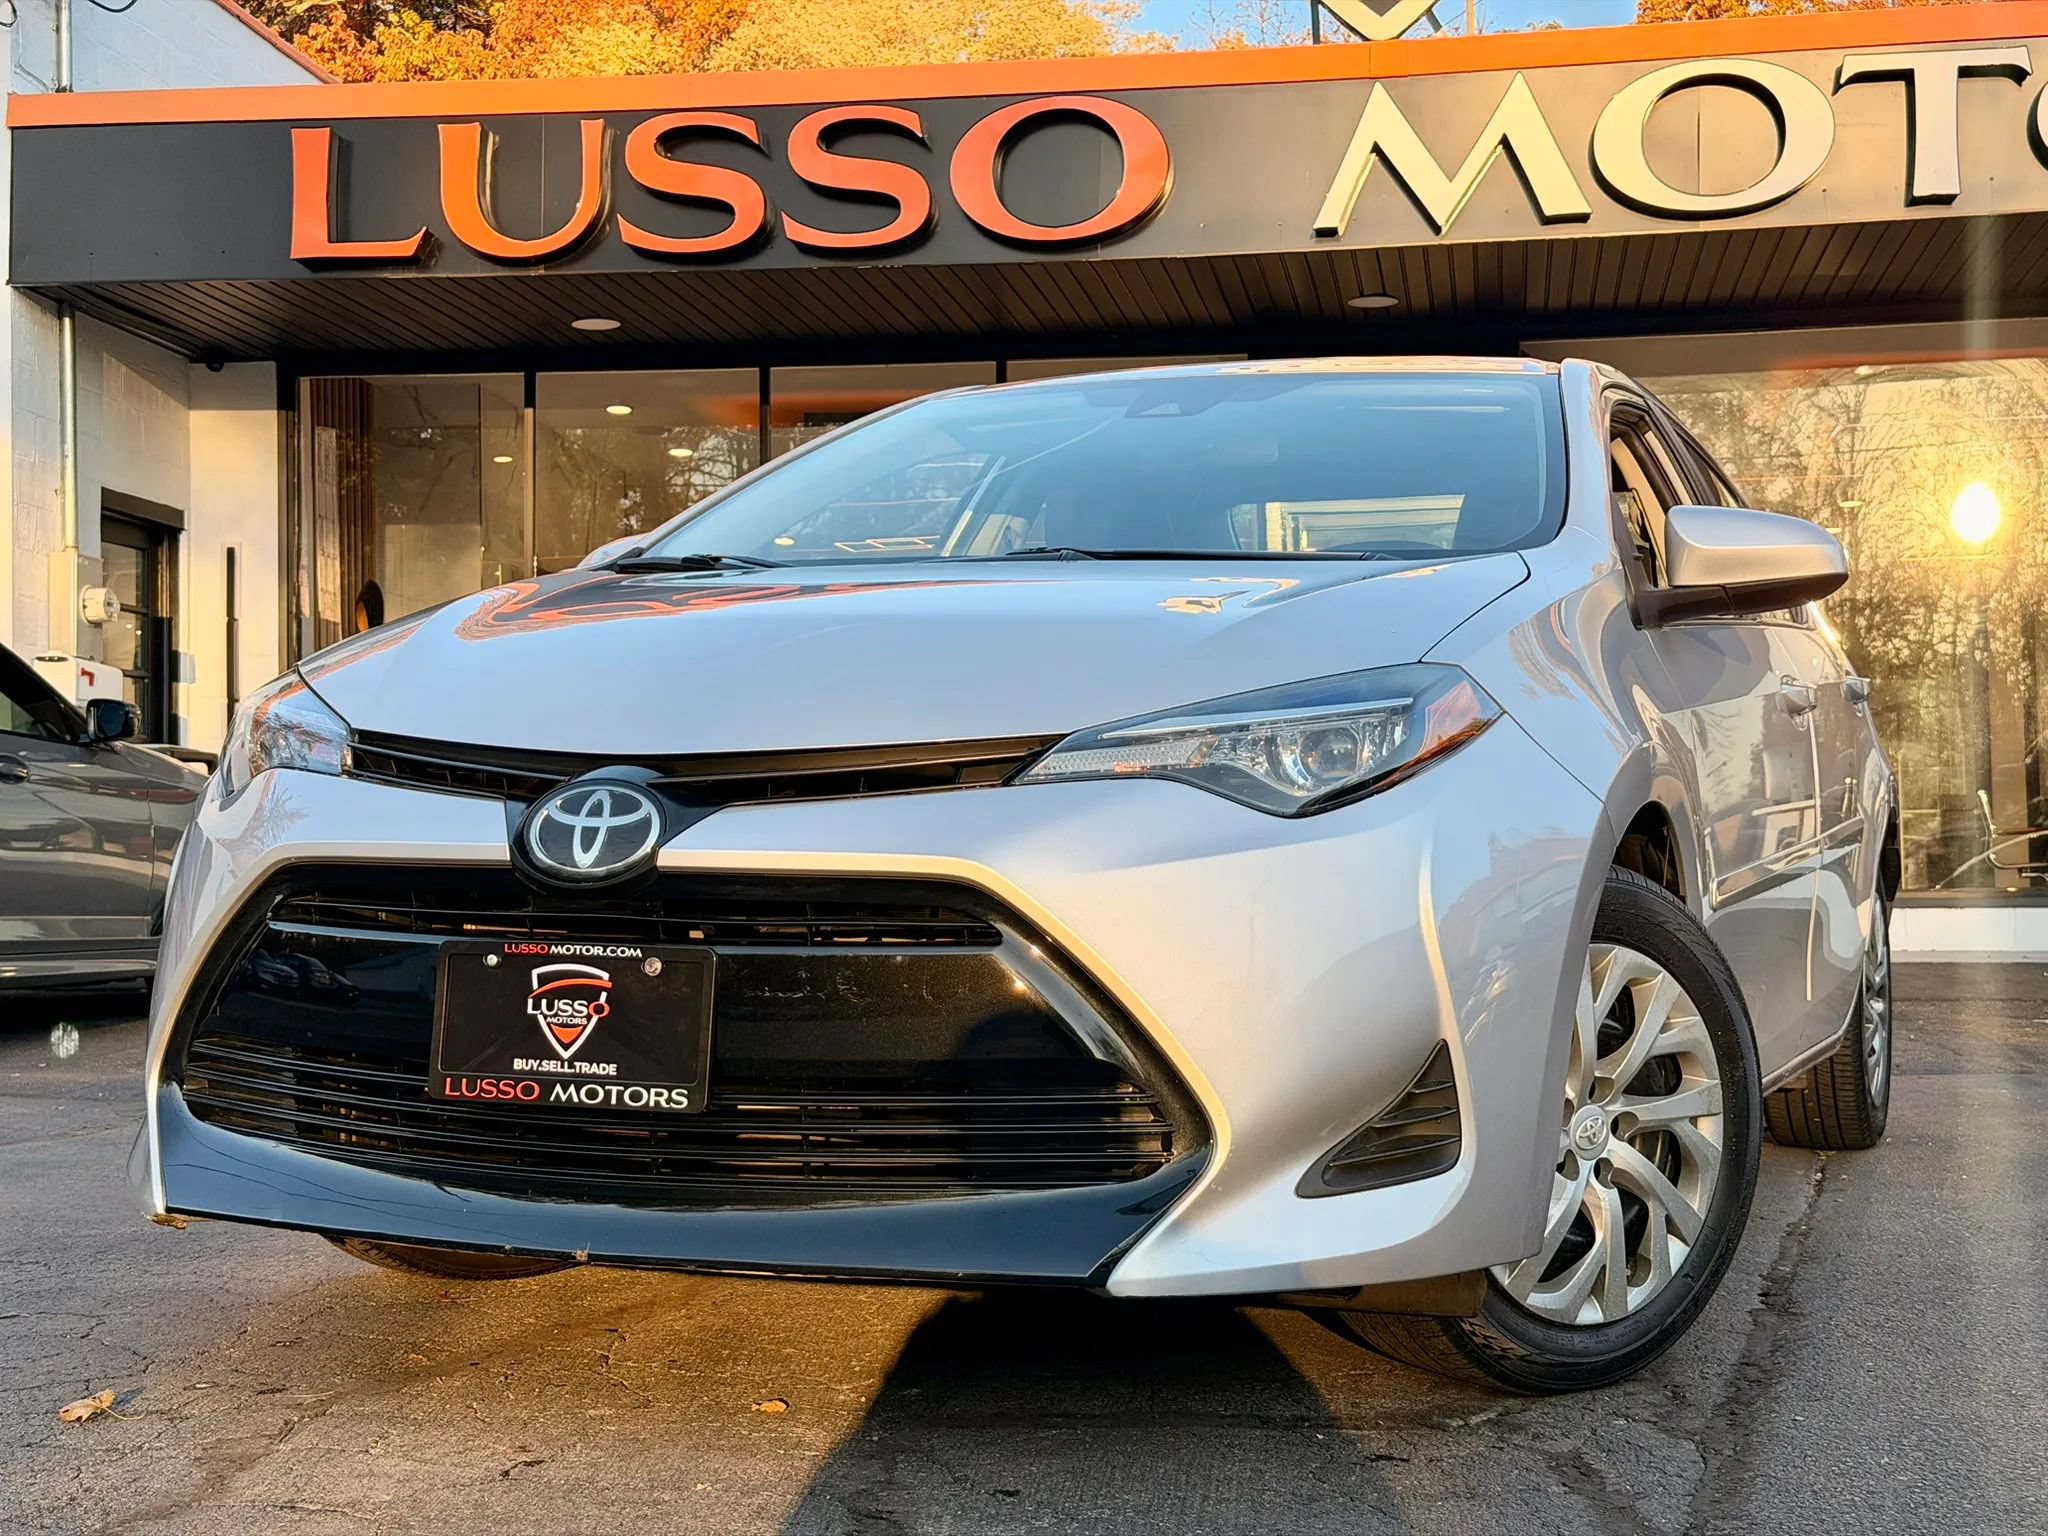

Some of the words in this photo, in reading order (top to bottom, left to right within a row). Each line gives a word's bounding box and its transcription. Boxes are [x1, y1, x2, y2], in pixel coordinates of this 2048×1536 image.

[290, 94, 1173, 262] LUSSO
[1312, 45, 2048, 237] MOT
[526, 998, 610, 1017] LUSSO
[546, 1016, 588, 1025] MOTORS
[444, 1077, 541, 1101] LUSSO
[549, 1082, 689, 1109] MOTORS
